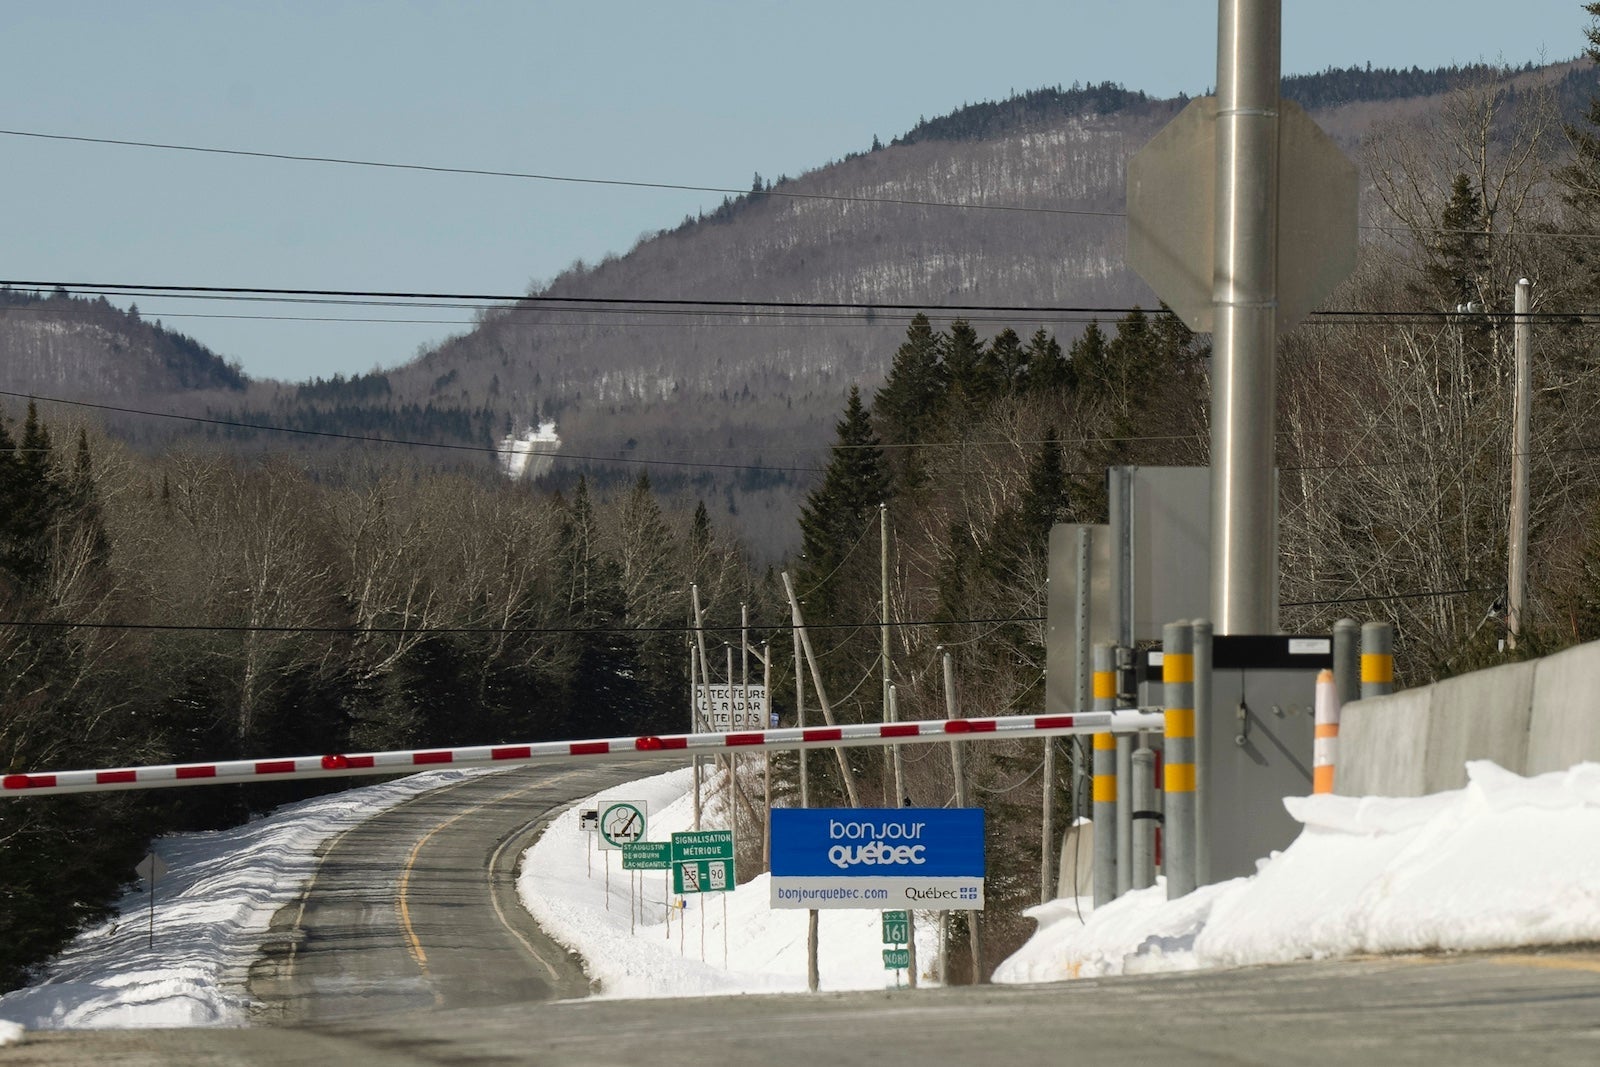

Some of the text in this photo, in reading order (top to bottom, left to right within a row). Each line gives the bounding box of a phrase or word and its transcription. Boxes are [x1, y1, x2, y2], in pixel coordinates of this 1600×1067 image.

[696, 689, 766, 699] DTECTEURS
[721, 701, 761, 711] RADAR
[829, 819, 926, 839] bonjour
[675, 834, 731, 844] SIGNALISATION
[683, 845, 721, 855] MÉTRIQUE
[828, 841, 926, 868] québec
[684, 870, 697, 880] 55
[711, 869, 723, 879] 90
[778, 887, 888, 903] bonjourquebec.com
[905, 887, 958, 901] Québec
[885, 924, 905, 941] 161
[884, 953, 908, 965] NORD
